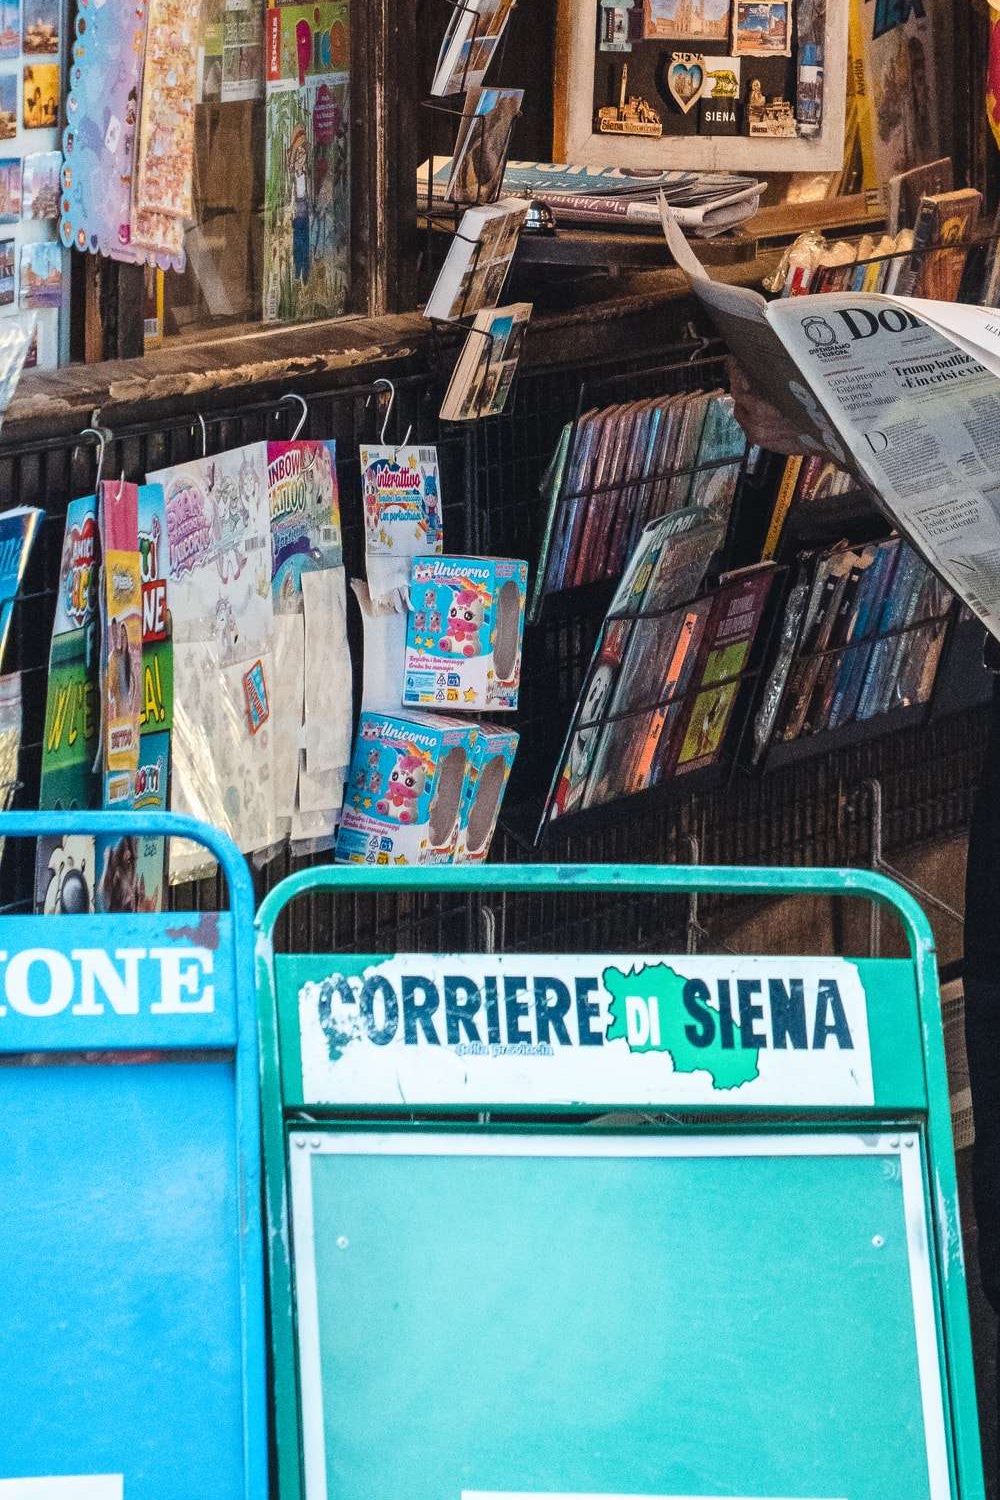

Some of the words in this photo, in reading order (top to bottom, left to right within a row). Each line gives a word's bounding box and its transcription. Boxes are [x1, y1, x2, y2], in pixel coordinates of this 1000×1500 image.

[601, 117, 623, 131] Siena
[705, 111, 736, 122] SIENA
[894, 361, 936, 377] Trump
[929, 368, 957, 385] crisi
[268, 449, 301, 486] INBOW
[377, 466, 420, 488] interattivo
[432, 561, 490, 579] Unicorno
[381, 722, 437, 748] Unicorno
[0, 947, 215, 1017] ONE
[318, 975, 603, 1047] CORRIERE
[626, 995, 660, 1047] DI
[683, 977, 855, 1050] SIENA
[454, 1042, 488, 1057] della
[491, 1041, 554, 1059] provincia
